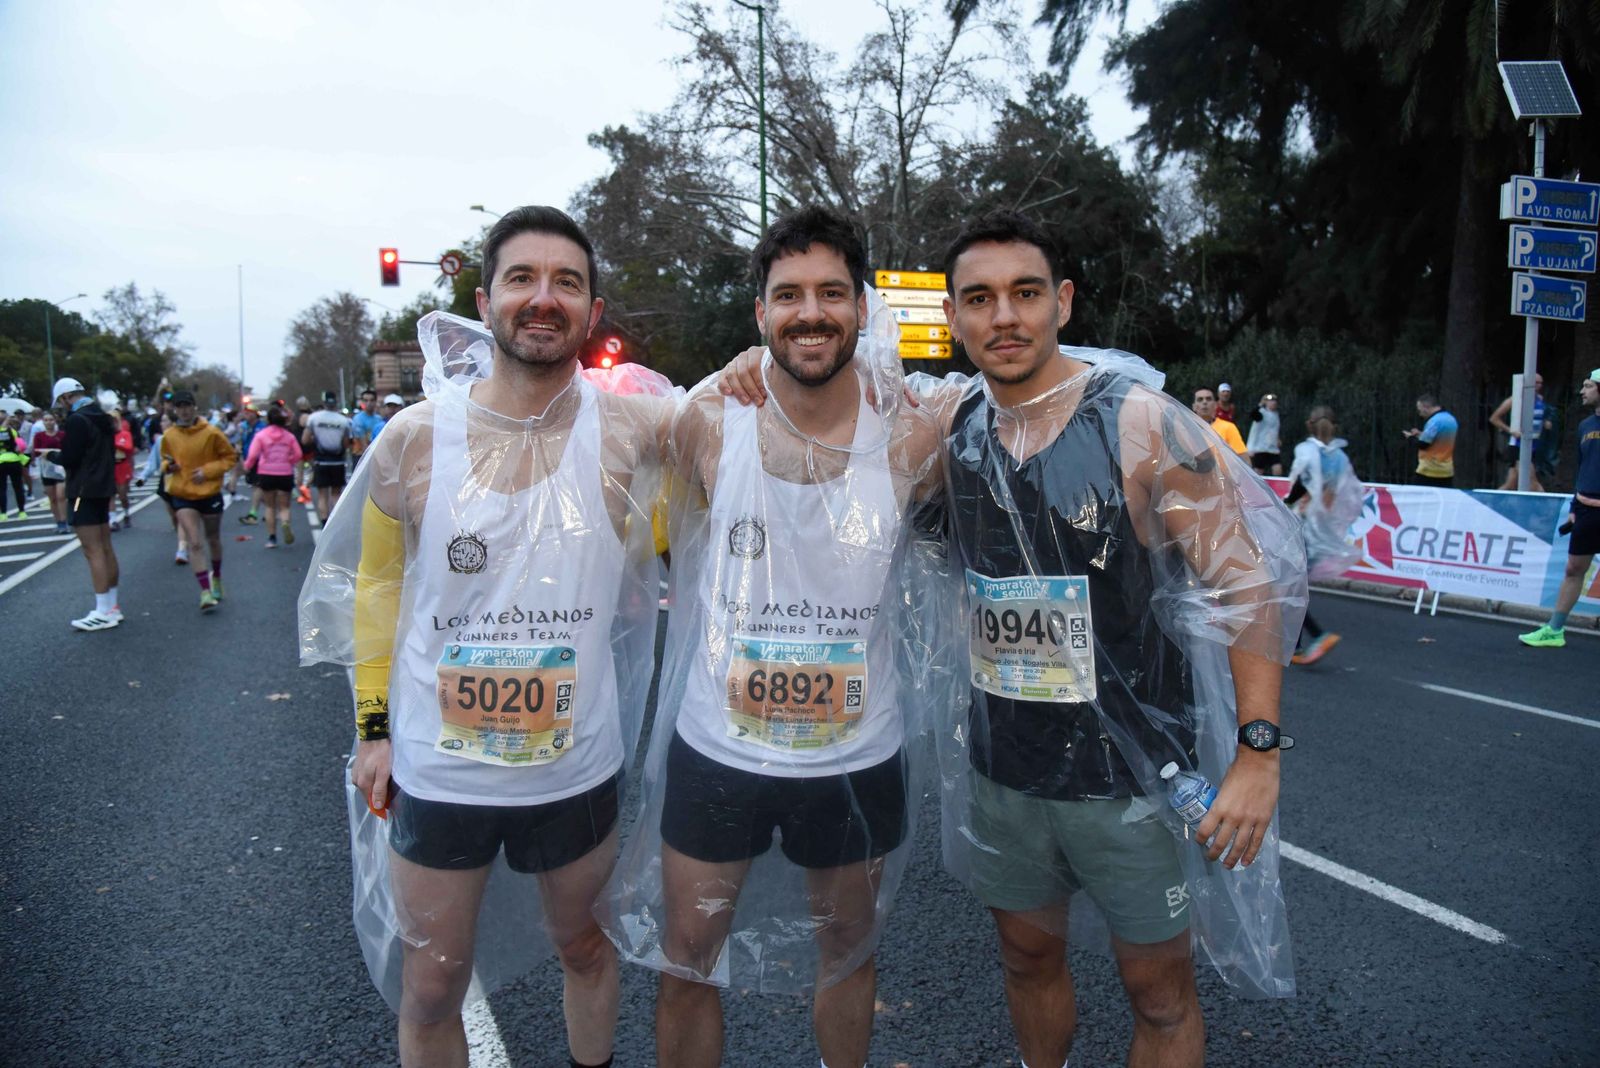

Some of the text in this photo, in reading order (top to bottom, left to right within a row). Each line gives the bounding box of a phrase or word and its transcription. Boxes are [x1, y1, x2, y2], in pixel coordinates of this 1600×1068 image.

[1516, 179, 1537, 216] P
[1526, 204, 1588, 221] AVD. ROMA
[1514, 231, 1535, 266] P
[1516, 276, 1535, 313] P
[1395, 525, 1527, 568] CREATE
[1425, 566, 1463, 579] Creativa
[1480, 575, 1520, 588] Eventos
[476, 604, 593, 625] MEDIANOS
[528, 628, 571, 640] TEAM
[816, 623, 859, 637] TEAM
[976, 604, 1067, 647] 19940
[483, 648, 533, 658] maratón
[772, 644, 822, 653] maratón
[495, 657, 533, 667] sevilla
[457, 675, 544, 713] 5020
[748, 669, 834, 705] 6892
[480, 714, 521, 725] Juan Guijo
